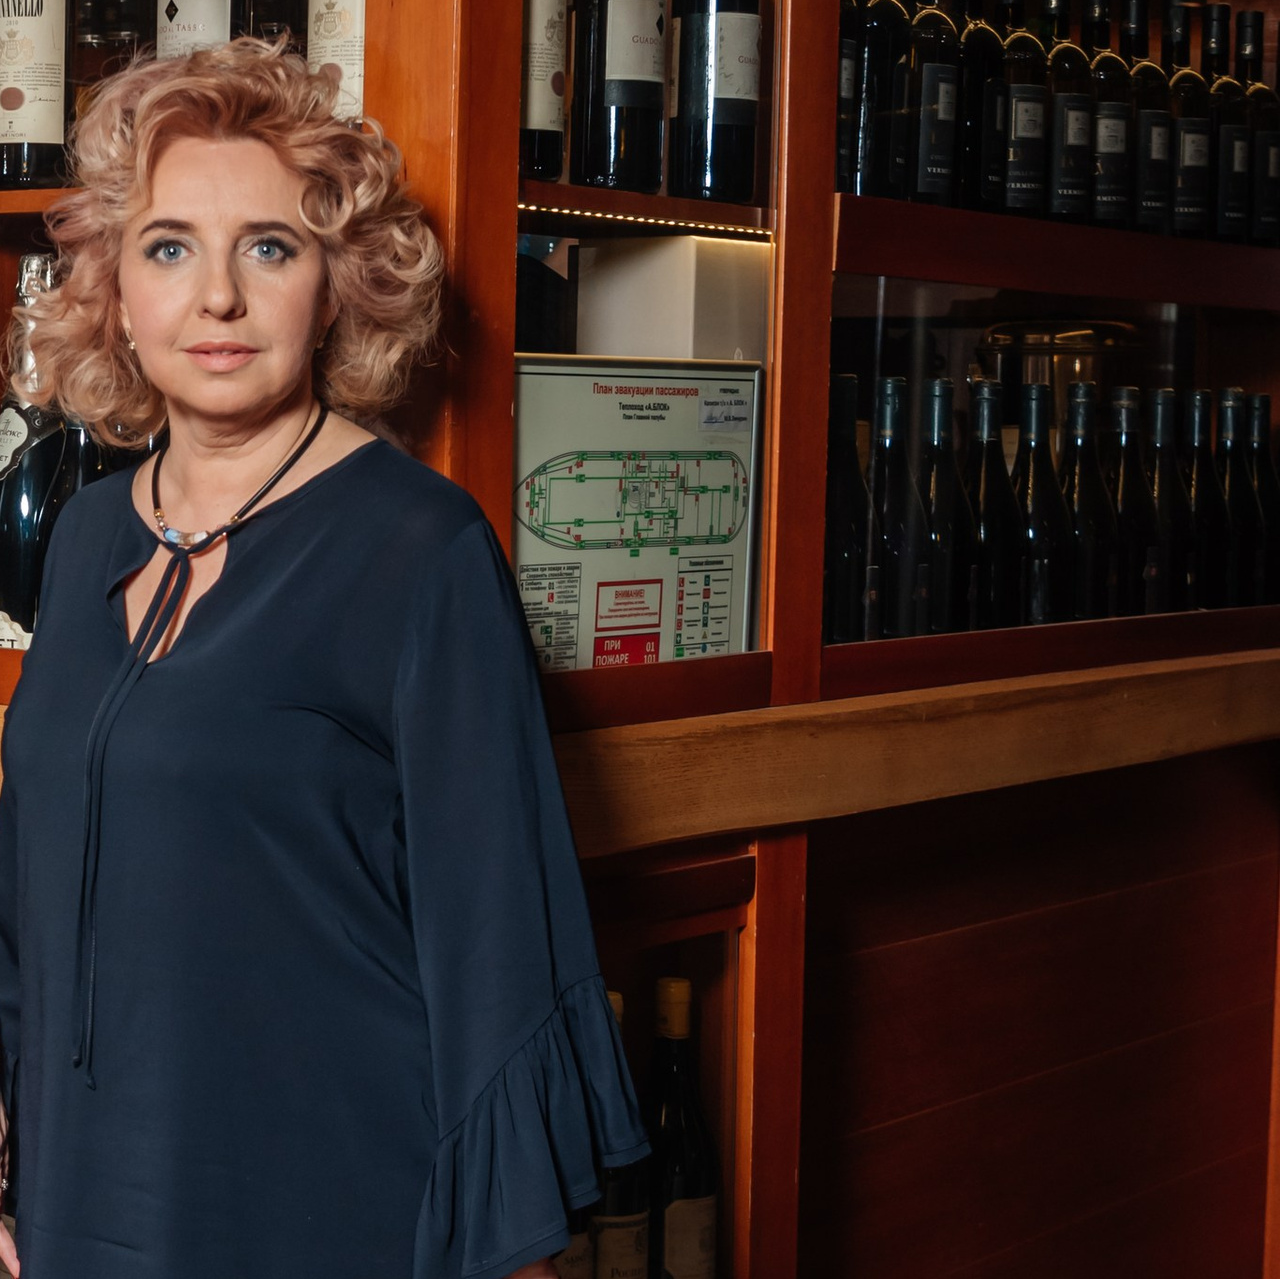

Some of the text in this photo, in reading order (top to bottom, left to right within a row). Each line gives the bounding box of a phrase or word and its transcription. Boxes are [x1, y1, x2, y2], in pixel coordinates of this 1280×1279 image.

[593, 382, 699, 398] План эвакуации пассажиров
[619, 402, 644, 412] Теплоход
[604, 640, 621, 651] ПРИ
[646, 641, 655, 652] 01
[595, 653, 629, 666] ПОЖАРЕ
